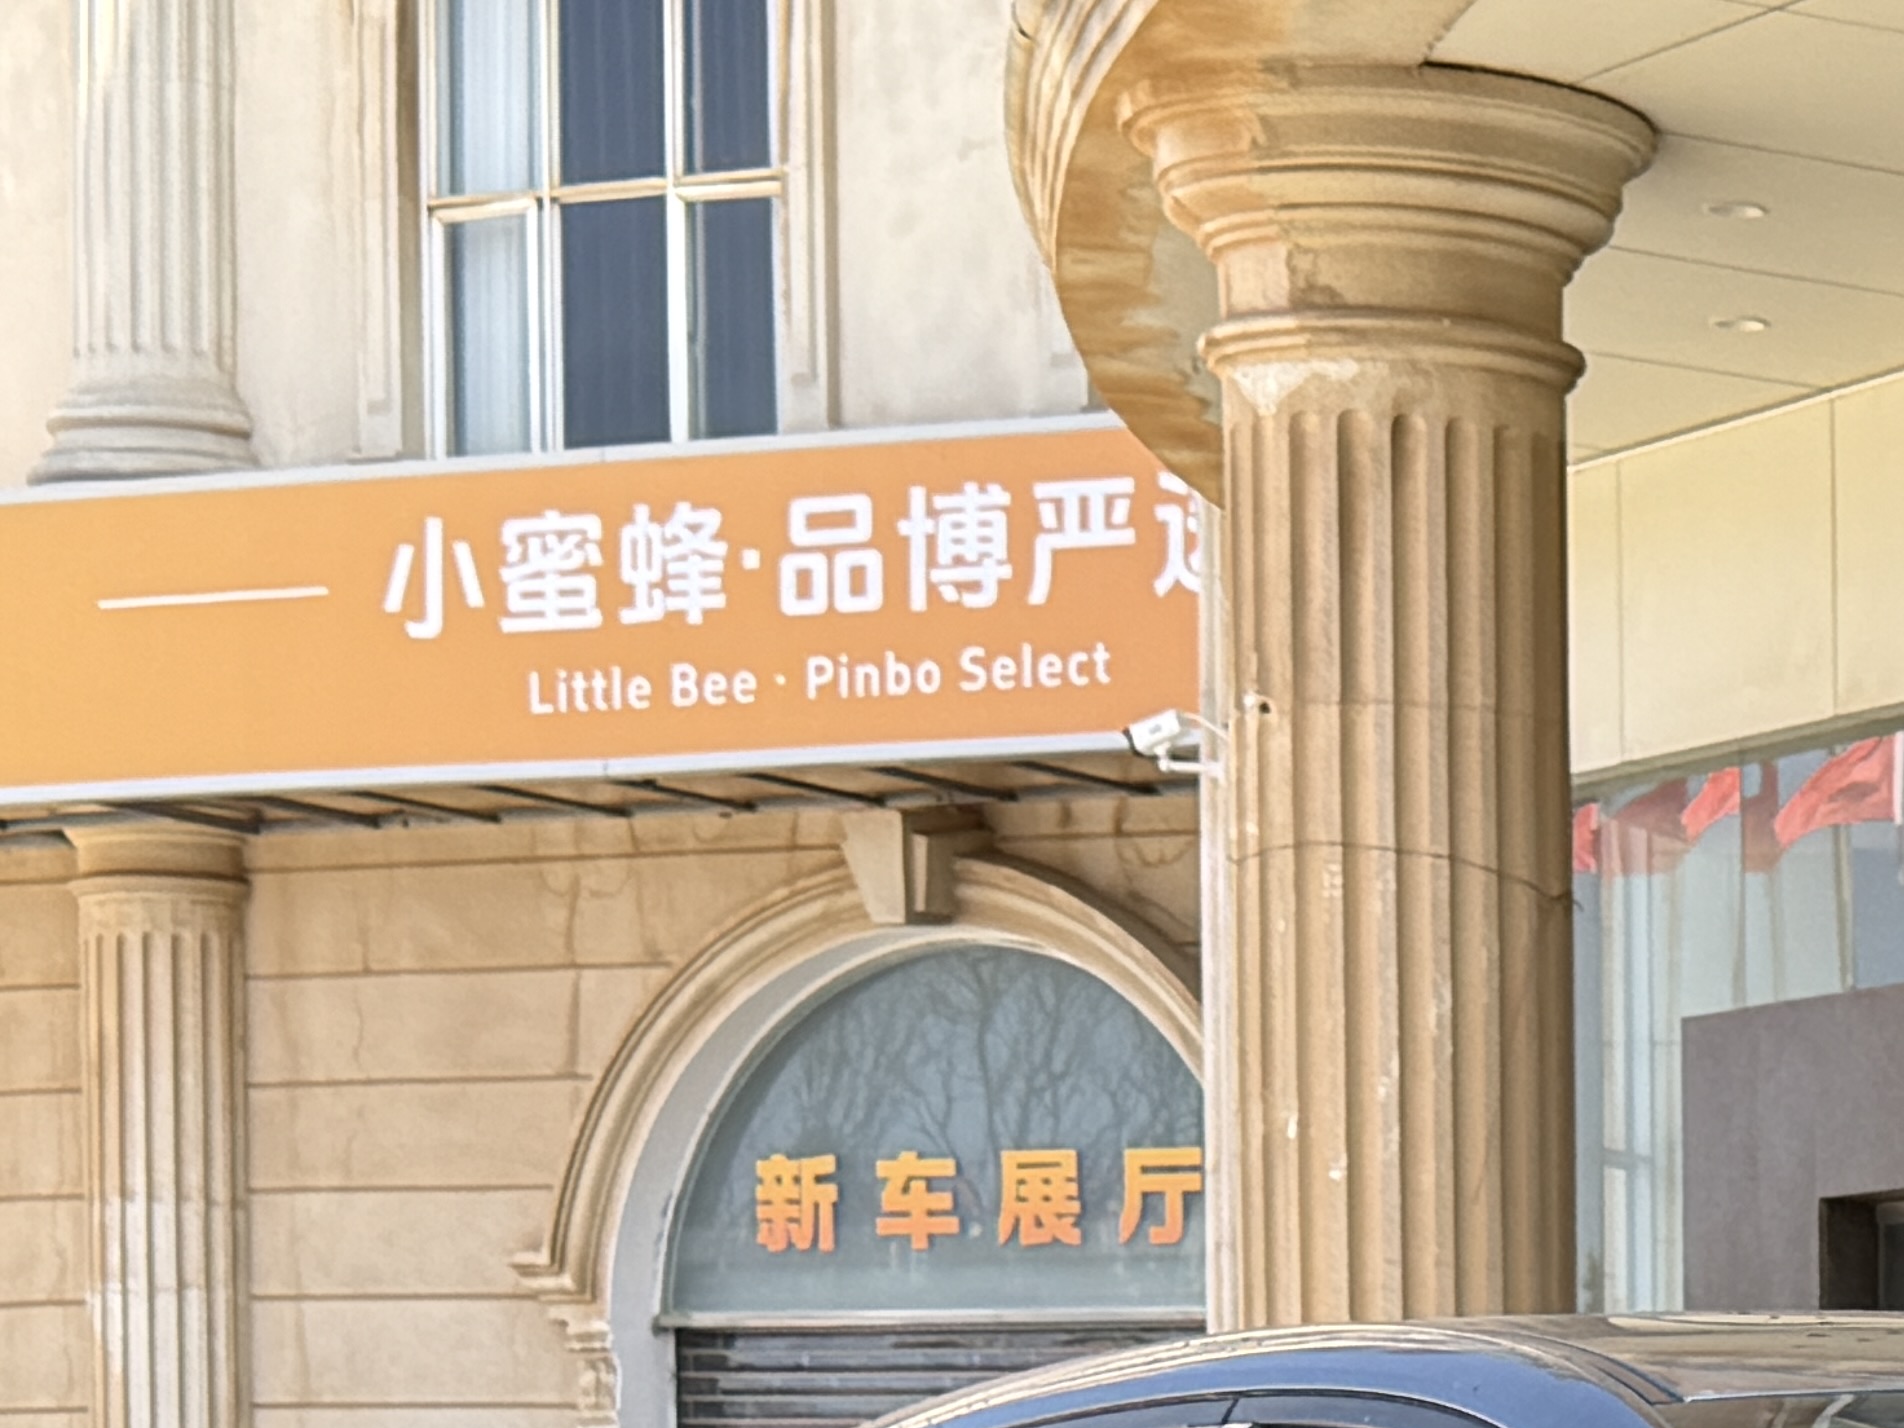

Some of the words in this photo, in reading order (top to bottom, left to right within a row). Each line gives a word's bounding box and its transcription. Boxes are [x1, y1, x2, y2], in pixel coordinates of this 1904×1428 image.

[528, 664, 651, 715] Little
[671, 663, 758, 709] Bee
[806, 651, 942, 700] Pinbo
[958, 641, 1112, 692] Select
[755, 1147, 1202, 1253] 新车展厅
